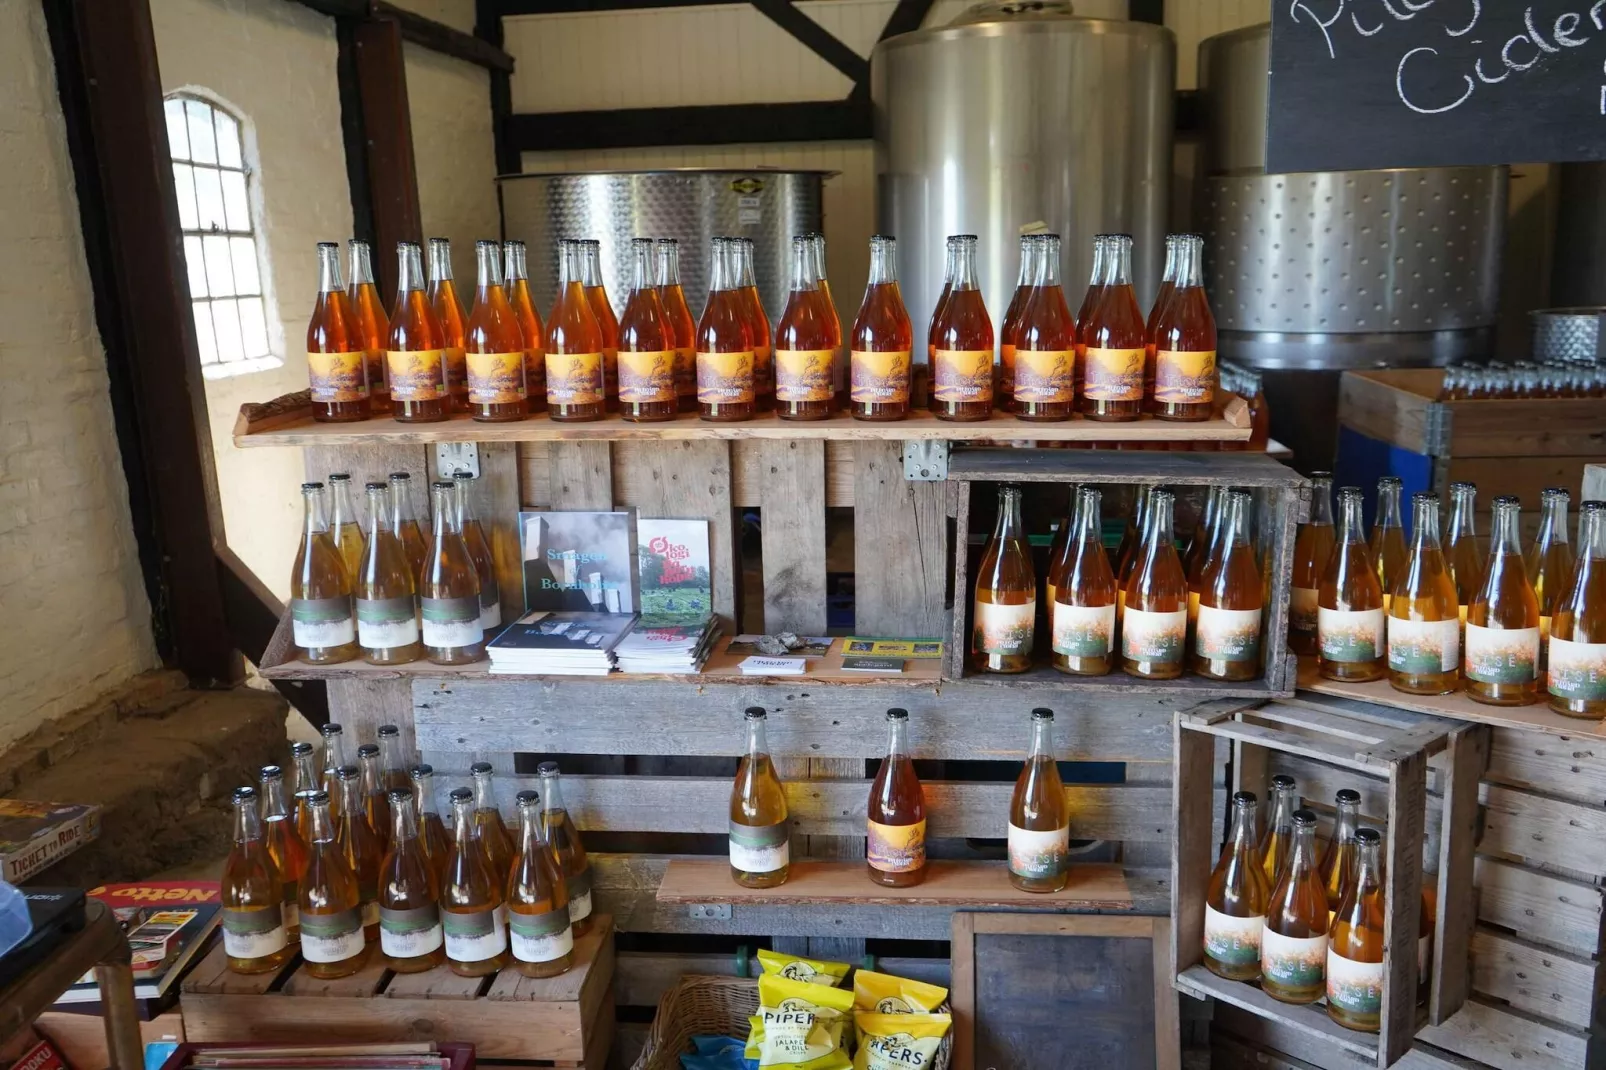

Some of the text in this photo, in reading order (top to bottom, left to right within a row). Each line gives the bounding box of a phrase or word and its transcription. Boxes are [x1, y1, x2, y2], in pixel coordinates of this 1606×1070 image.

[9, 825, 80, 876] TICKET TO RIDE
[111, 887, 218, 901] Netto
[764, 1012, 816, 1025] PIPER
[775, 1039, 803, 1047] JALAPE
